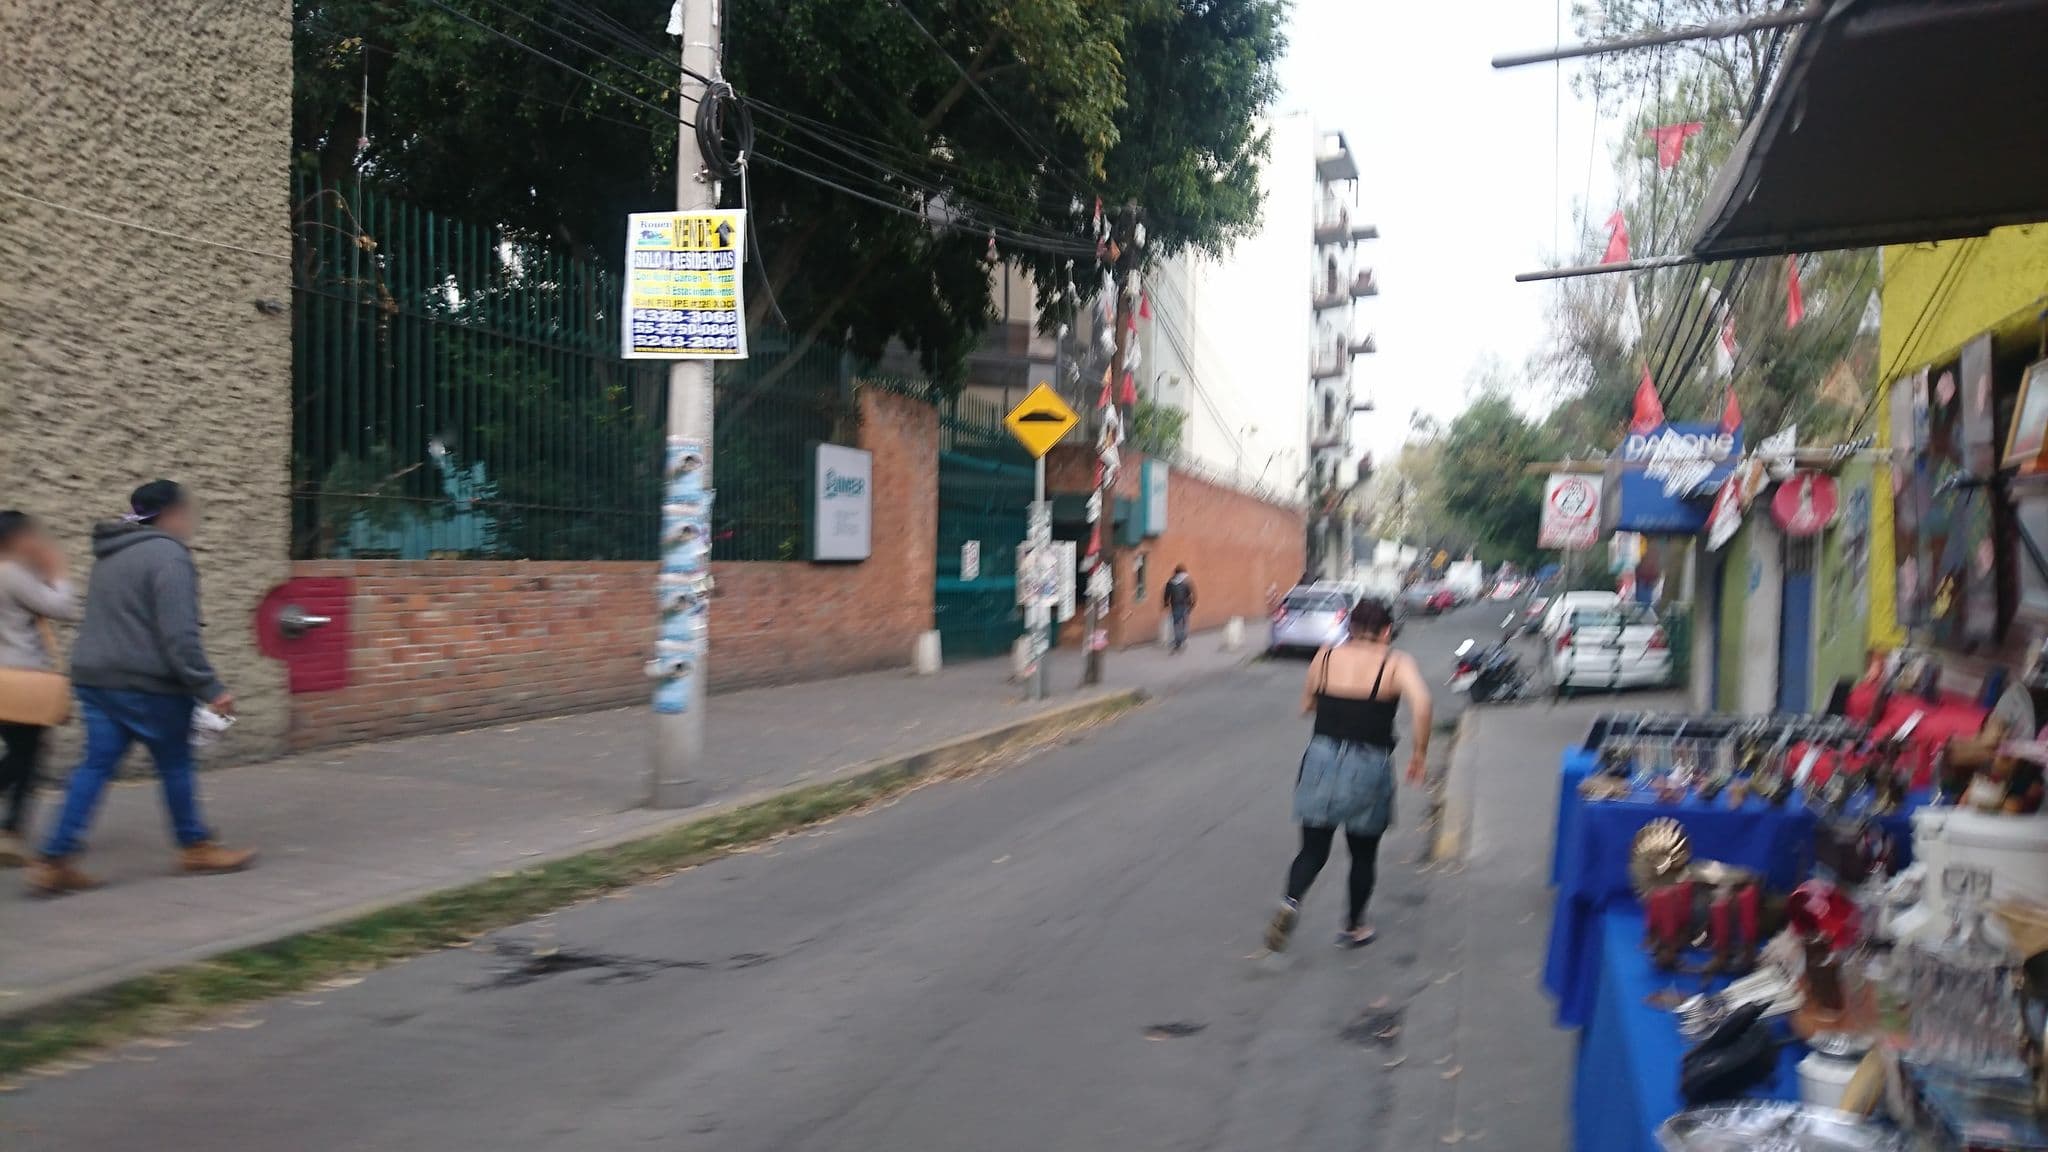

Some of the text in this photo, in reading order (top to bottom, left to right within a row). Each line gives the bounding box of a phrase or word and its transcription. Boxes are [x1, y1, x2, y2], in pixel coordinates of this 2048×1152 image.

[674, 219, 712, 248] VENDE
[635, 251, 661, 269] SOLO
[672, 251, 734, 270] RESIDENCIAS
[656, 299, 689, 309] FELIPE
[633, 310, 737, 323] 4328-3068
[633, 322, 738, 336] 55-2750-0846
[1625, 432, 1735, 462] DAONE
